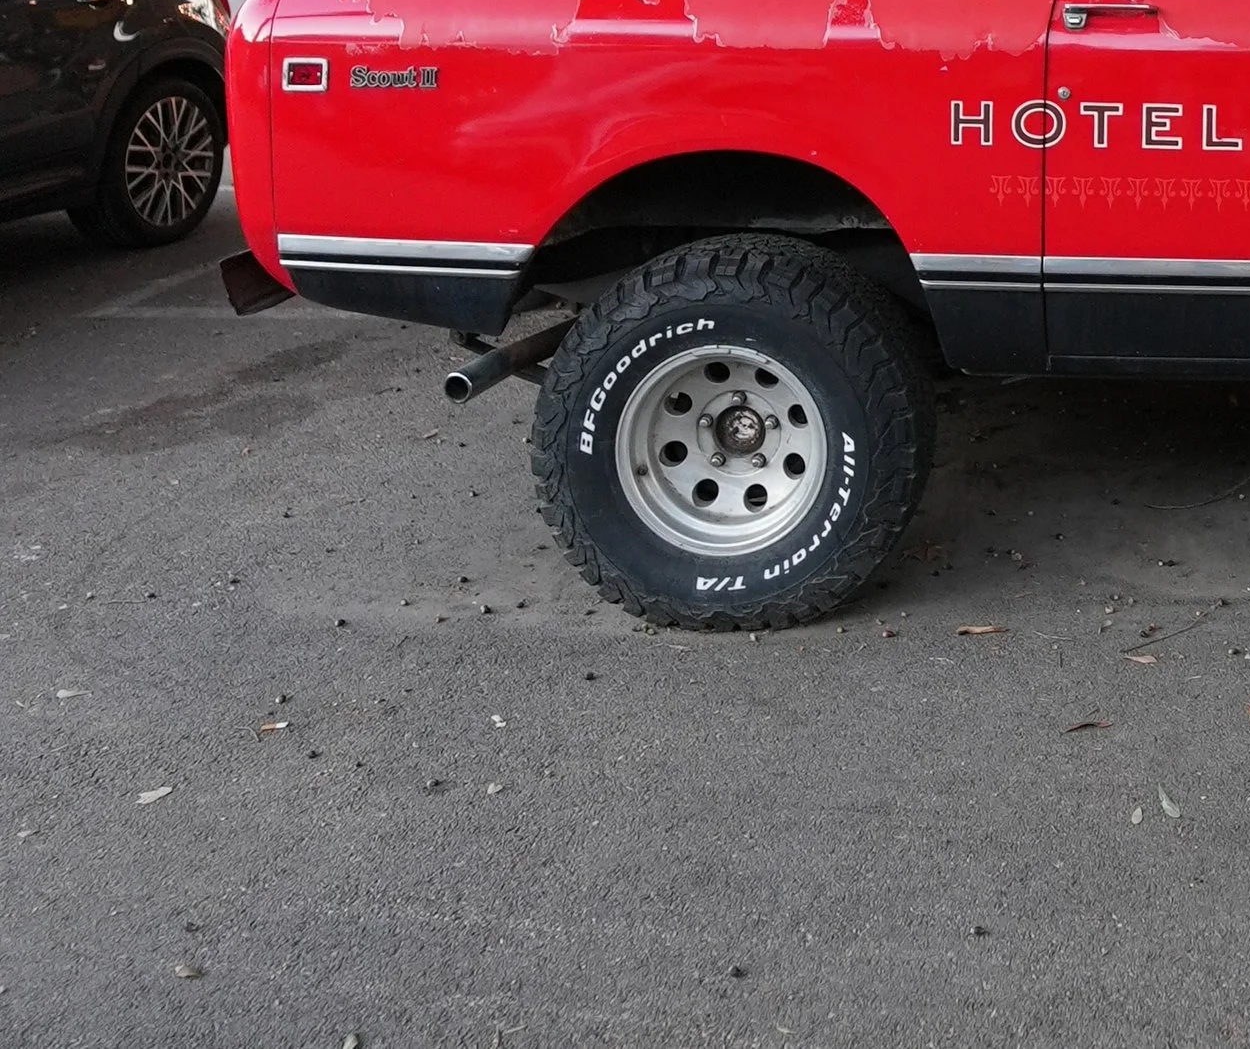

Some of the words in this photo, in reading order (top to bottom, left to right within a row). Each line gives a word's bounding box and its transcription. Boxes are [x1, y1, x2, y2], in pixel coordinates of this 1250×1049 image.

[350, 65, 417, 88] Scout
[419, 66, 438, 88] II
[950, 99, 1243, 151] HOTEL
[579, 318, 716, 455] BFGoodrich
[763, 431, 856, 581] All-Terrain
[696, 576, 747, 592] T/A
